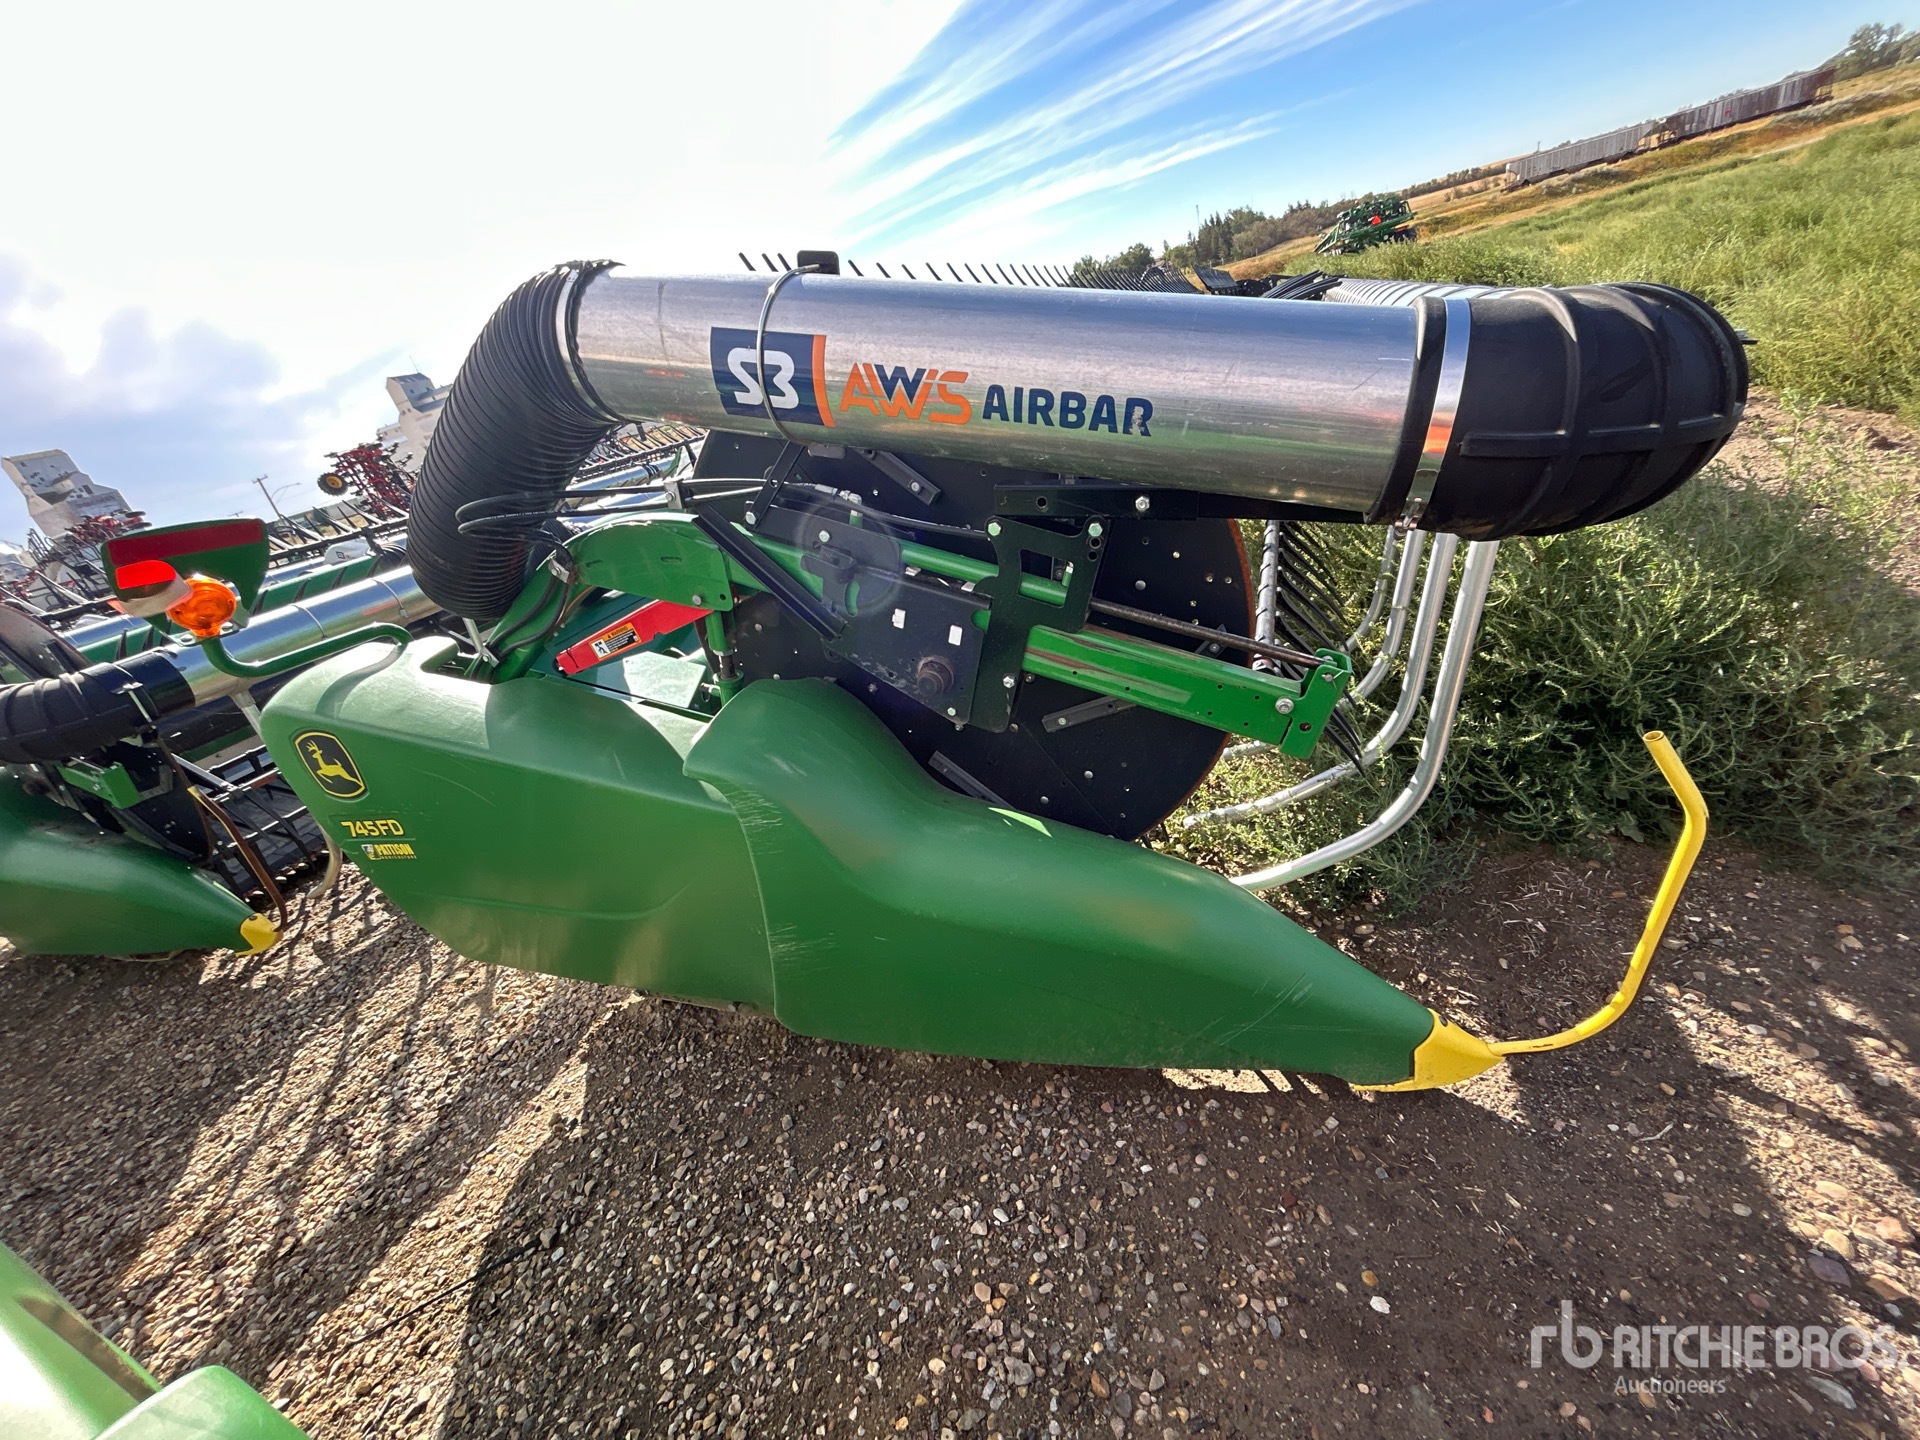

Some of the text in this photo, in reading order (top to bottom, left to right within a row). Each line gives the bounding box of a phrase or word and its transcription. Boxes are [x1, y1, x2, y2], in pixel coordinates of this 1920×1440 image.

[839, 362, 1154, 438] AWS AIRBAR
[340, 819, 404, 838] 745FD
[373, 843, 415, 855] PATTISON
